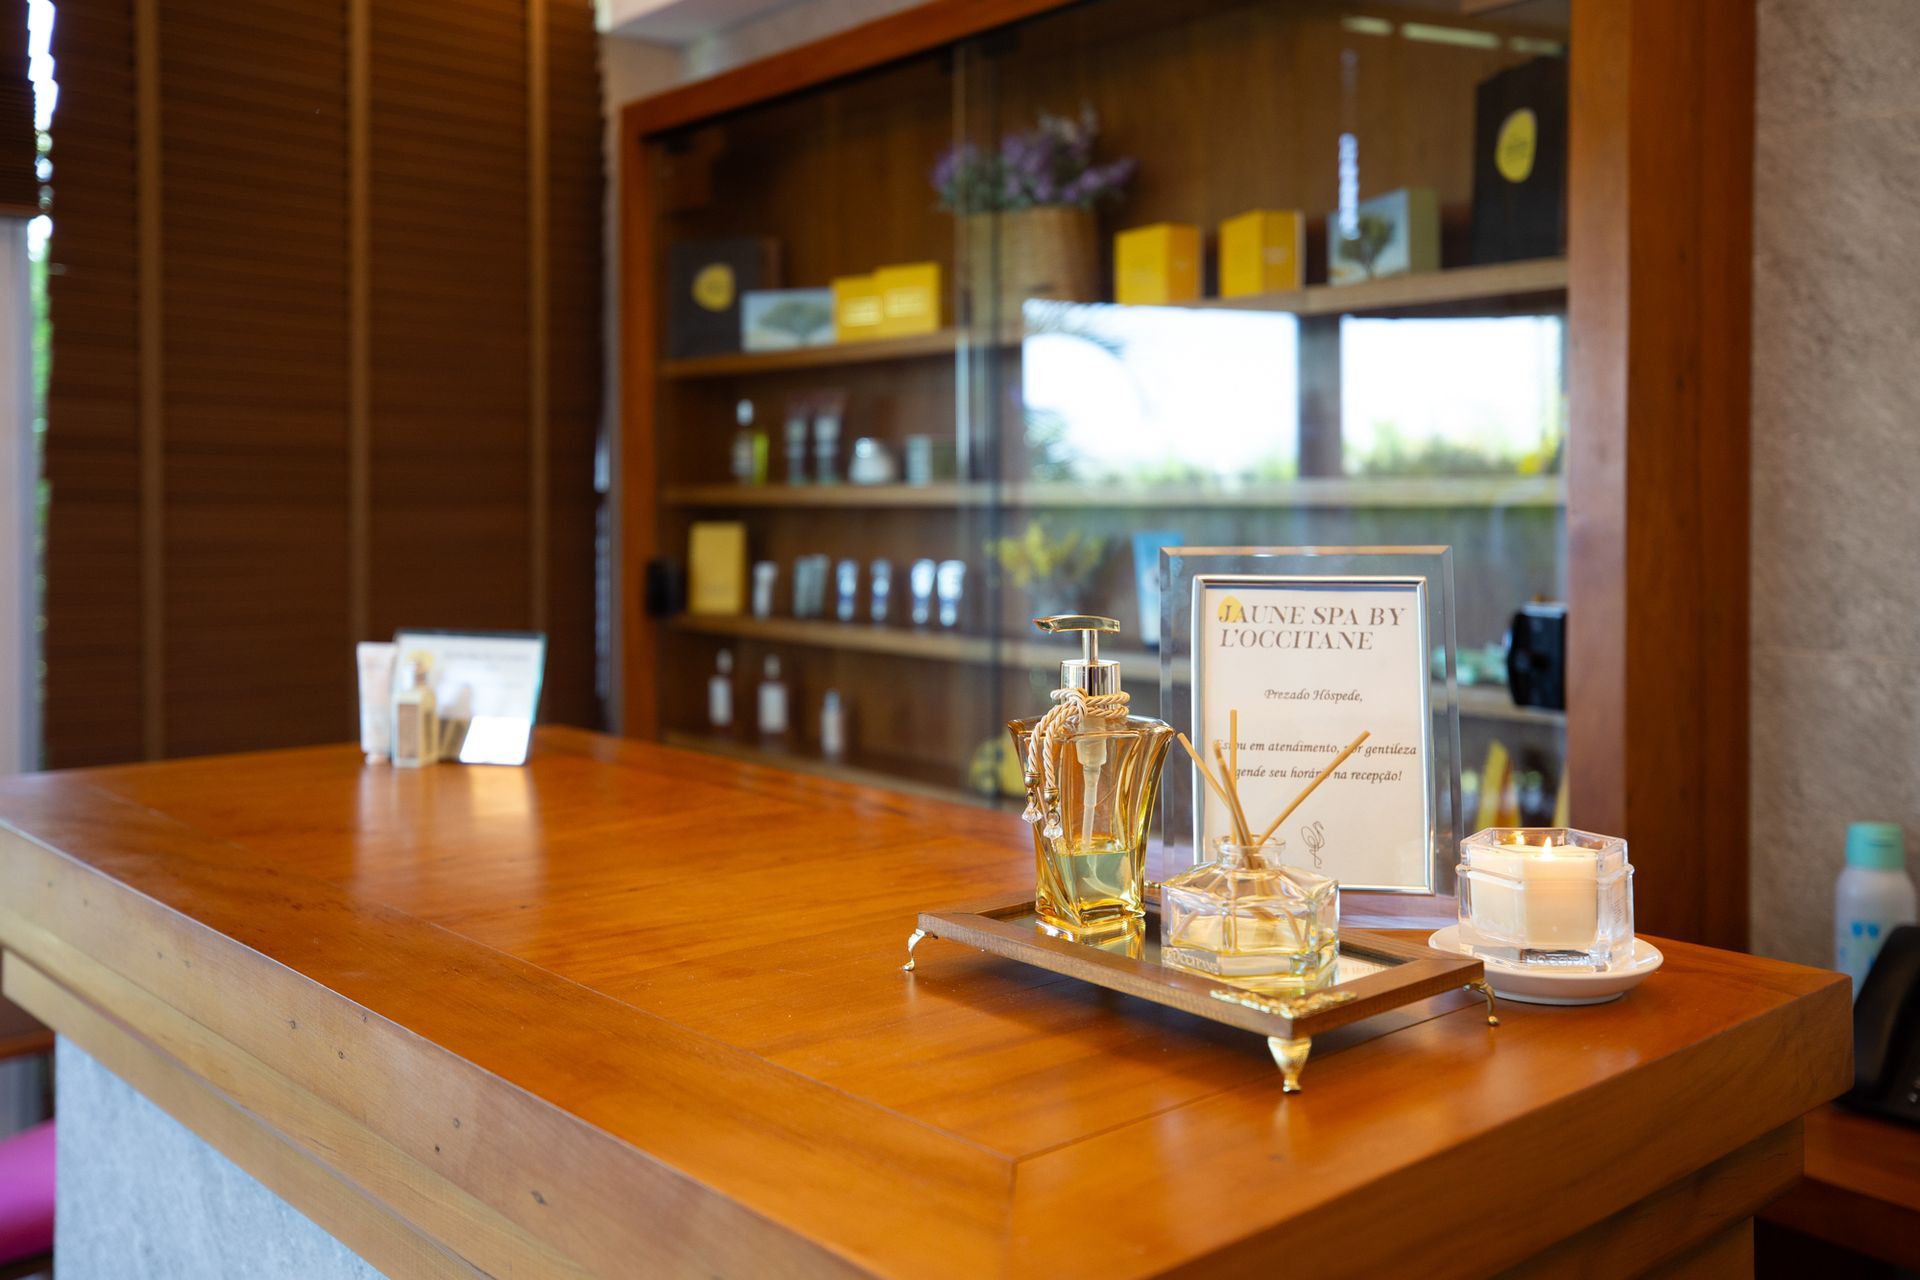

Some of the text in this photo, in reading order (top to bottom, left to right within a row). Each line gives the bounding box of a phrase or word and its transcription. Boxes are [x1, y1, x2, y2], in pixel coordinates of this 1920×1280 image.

[1219, 604, 1408, 627] JAUNE SPA BY
[1219, 628, 1374, 651] L'OCCITANE
[1263, 687, 1364, 705] Prezado Hóspede,
[1249, 742, 1266, 752] em
[1267, 740, 1340, 755] atendimento,
[1364, 741, 1417, 758] gentileza
[1234, 764, 1267, 780] gende
[1268, 768, 1288, 778] seu
[1333, 770, 1348, 780] na
[1350, 769, 1403, 785] recepção!
